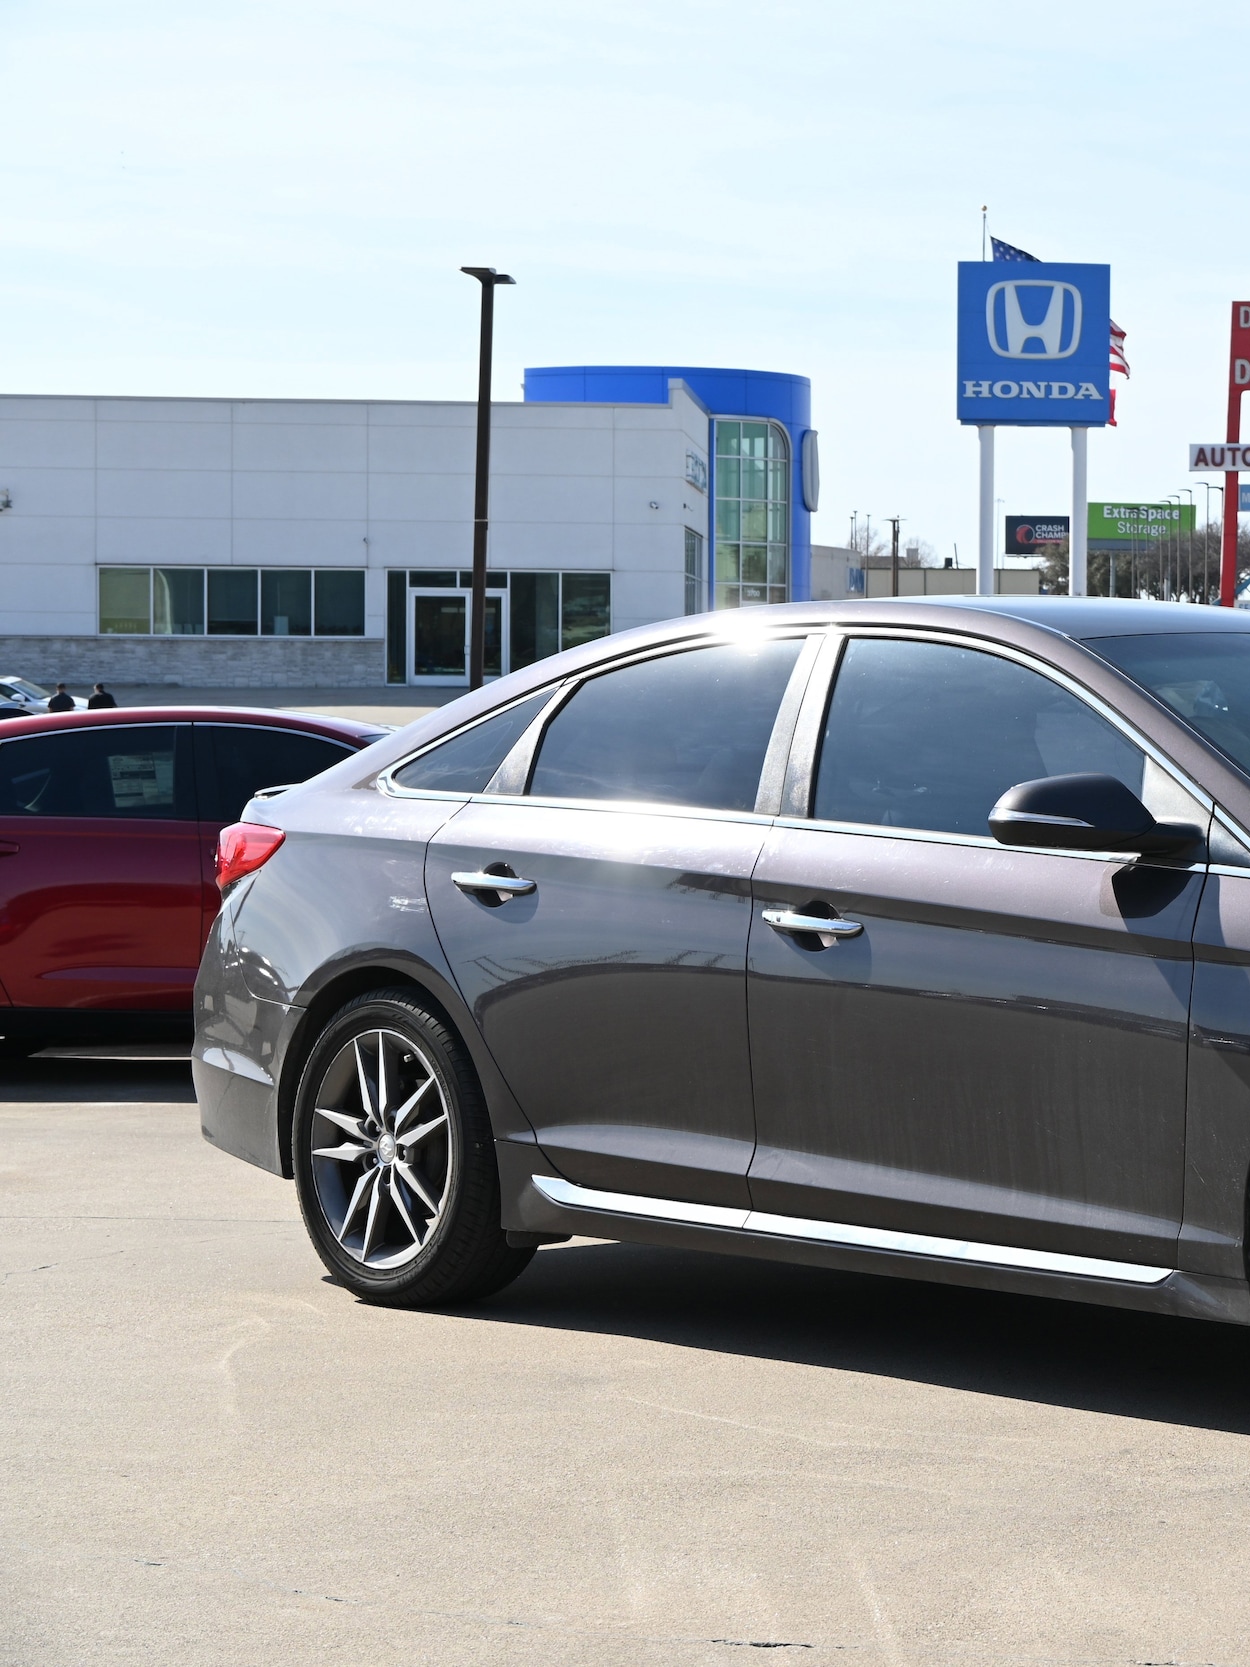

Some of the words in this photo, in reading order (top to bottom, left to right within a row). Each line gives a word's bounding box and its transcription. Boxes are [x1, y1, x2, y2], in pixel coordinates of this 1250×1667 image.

[962, 380, 1104, 400] HONDA
[1103, 505, 1137, 518] Extra
[1139, 506, 1180, 521] Space
[1035, 524, 1065, 532] CRASH
[1117, 521, 1167, 537] Storage
